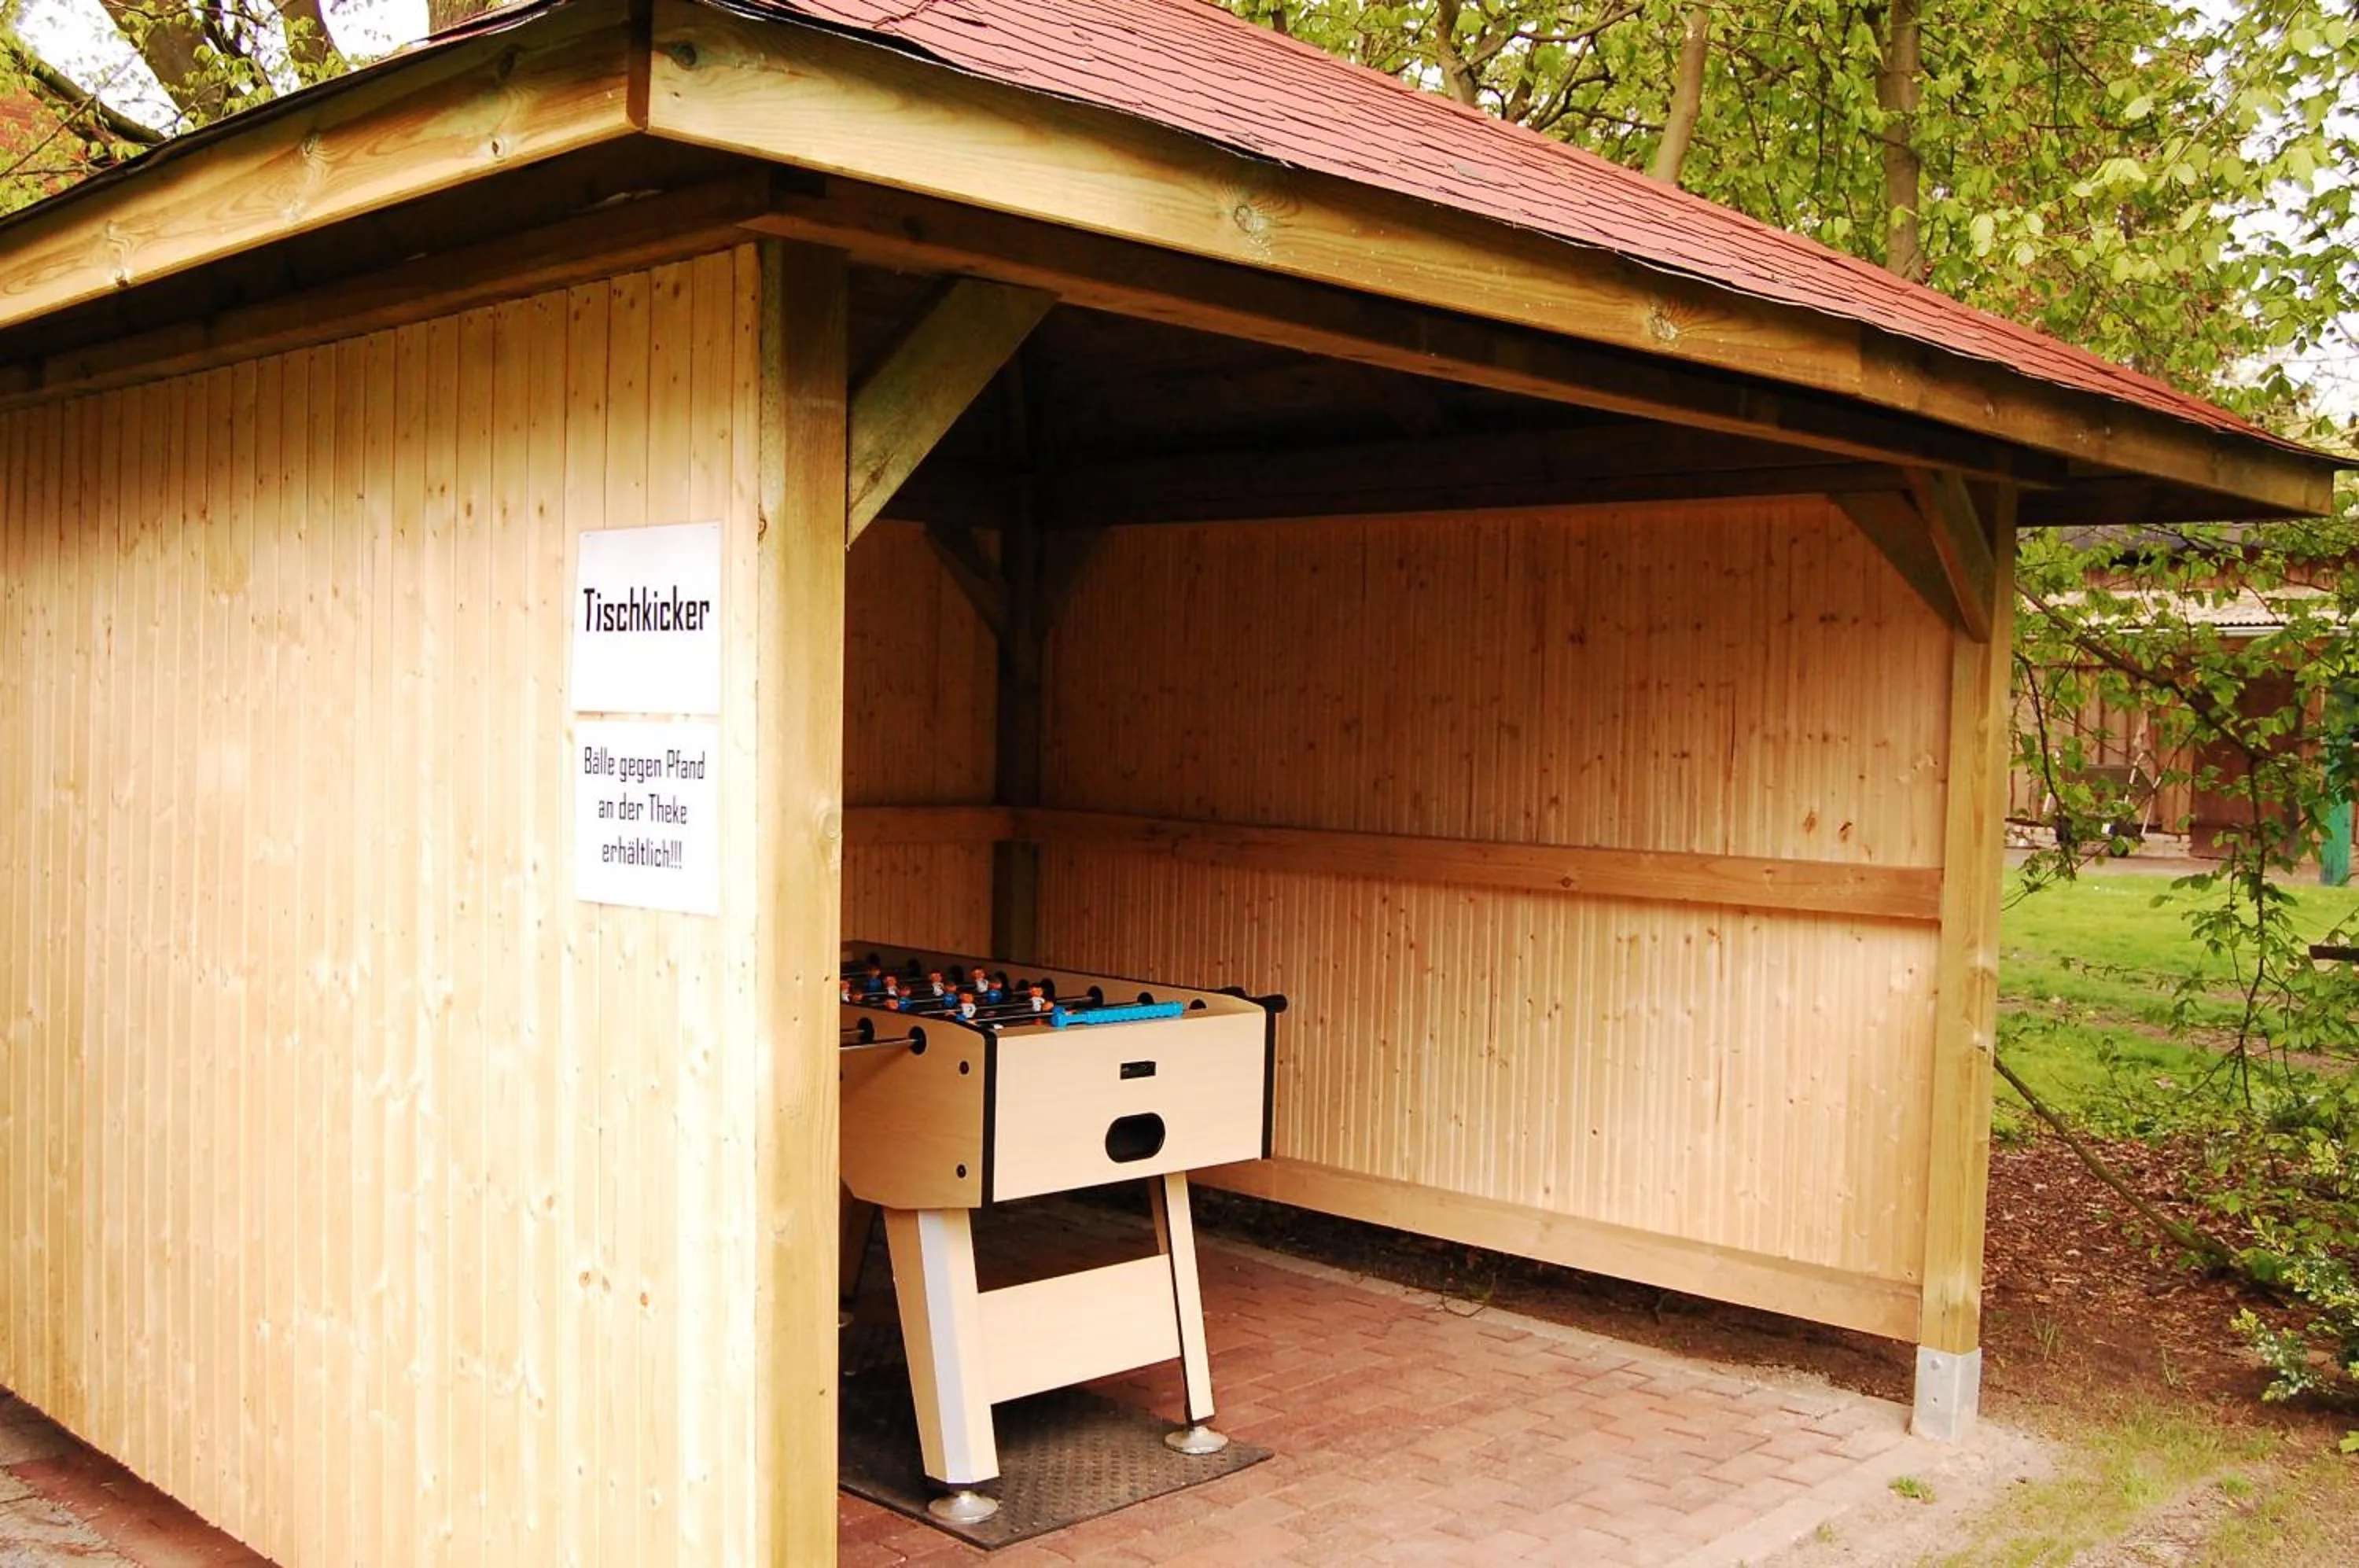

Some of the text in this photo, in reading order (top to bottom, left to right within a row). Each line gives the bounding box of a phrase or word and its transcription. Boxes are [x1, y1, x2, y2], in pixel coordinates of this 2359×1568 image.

[583, 585, 710, 632] Tischkicker
[584, 746, 705, 783] Bälle gegen Pfand
[598, 793, 686, 824] an der Theke
[602, 837, 682, 869] erhältlich!!!
